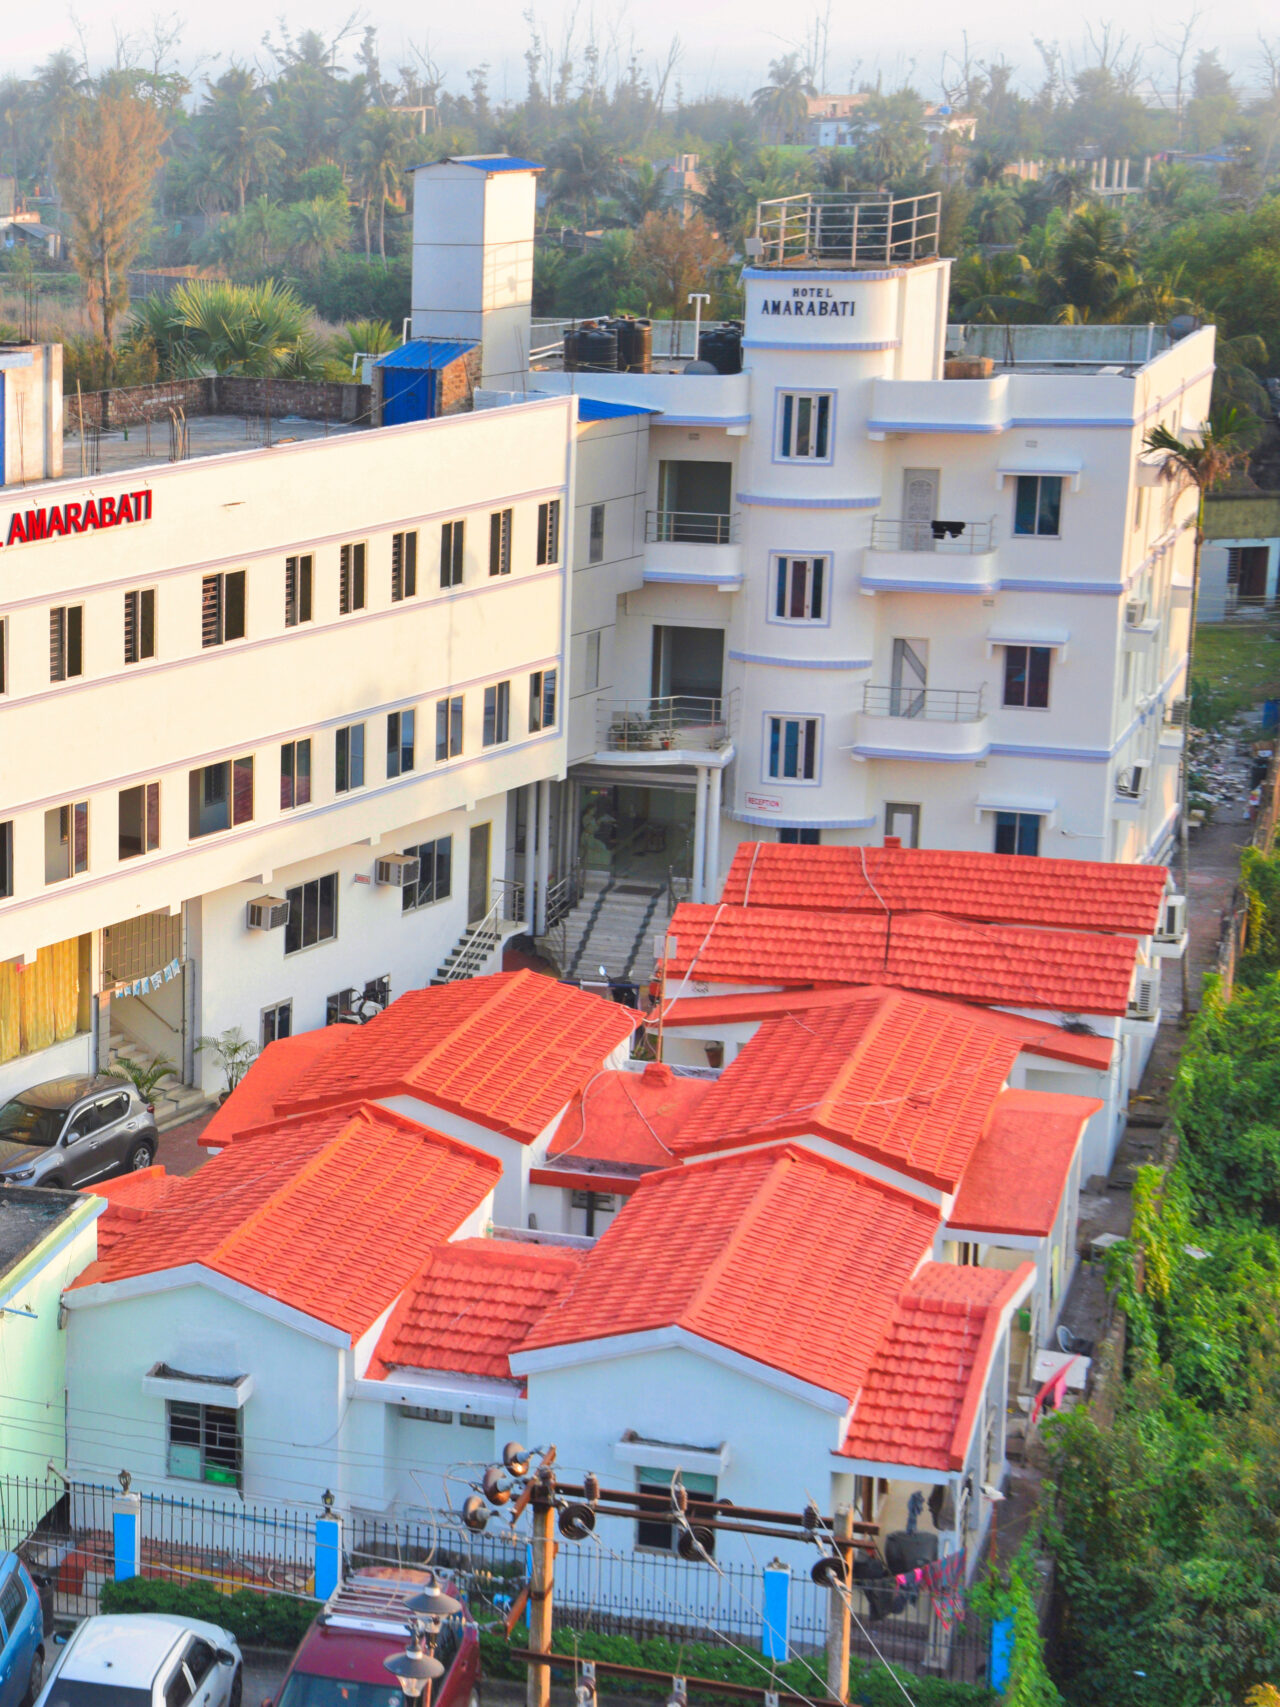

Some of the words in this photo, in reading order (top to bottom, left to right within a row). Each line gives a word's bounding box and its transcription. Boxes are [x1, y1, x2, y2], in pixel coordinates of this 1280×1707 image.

[792, 288, 833, 298] HOTEL
[761, 300, 856, 316] AMARABATI
[6, 489, 152, 546] AMARABATI
